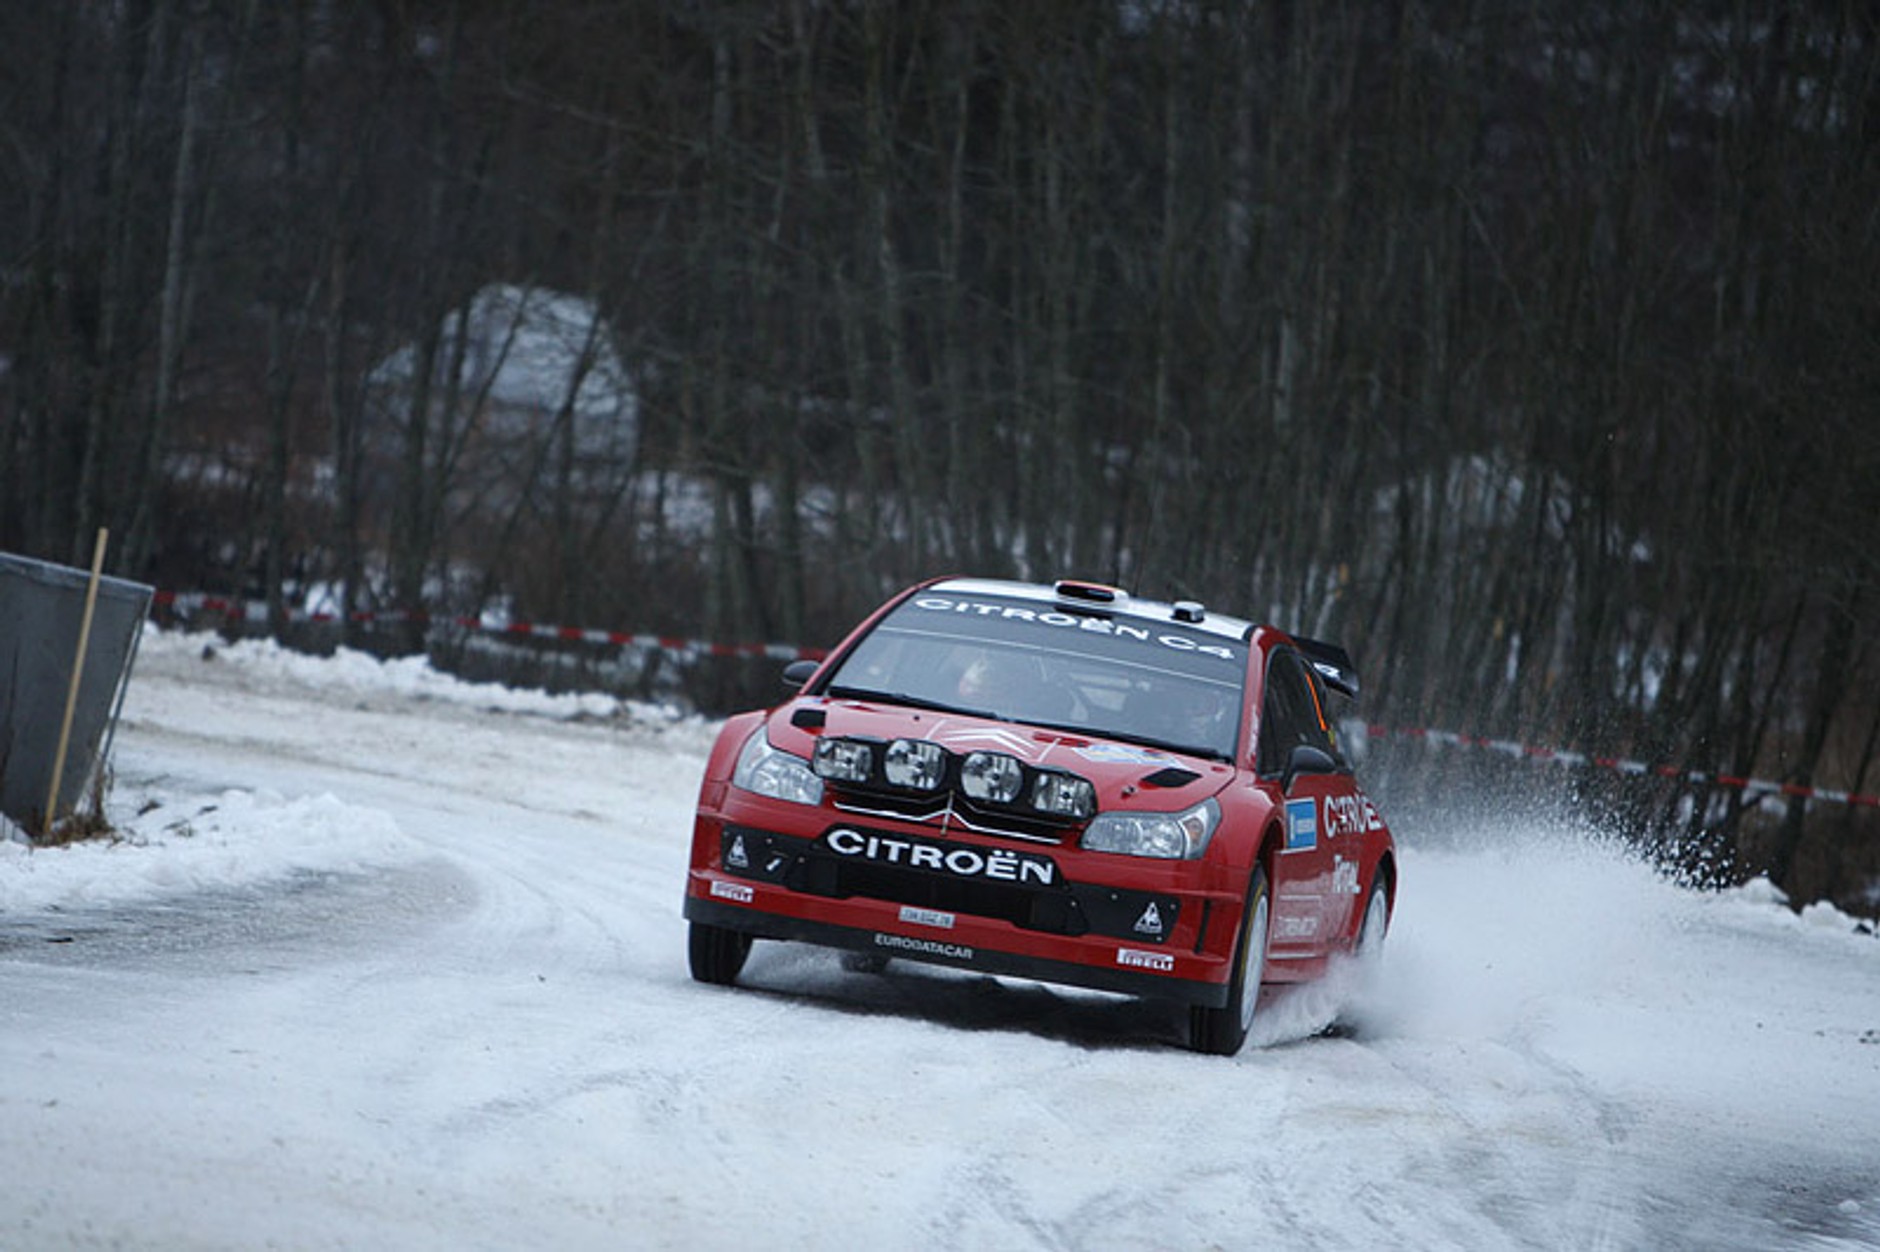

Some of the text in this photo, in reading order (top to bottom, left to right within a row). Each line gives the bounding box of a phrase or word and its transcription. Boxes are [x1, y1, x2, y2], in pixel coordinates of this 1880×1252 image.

[915, 598, 1235, 660] CITROËN C4
[826, 828, 1055, 886] CITROËN
